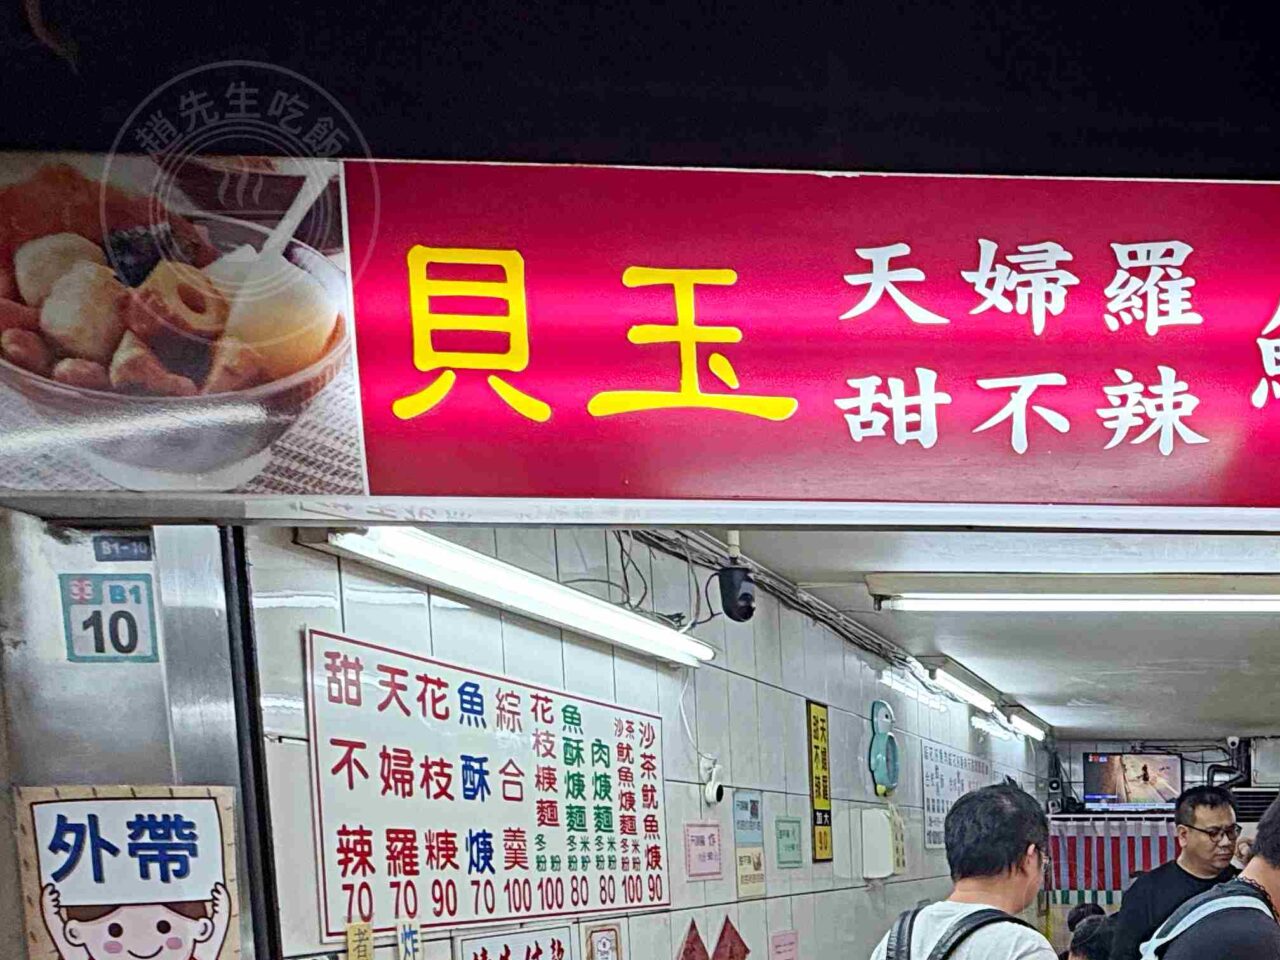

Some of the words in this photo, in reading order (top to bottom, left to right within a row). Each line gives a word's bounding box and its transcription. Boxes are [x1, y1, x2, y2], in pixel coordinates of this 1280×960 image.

[839, 238, 1202, 335] 天婦羅
[392, 244, 799, 422] 貝玉
[834, 365, 1209, 455] 甜不辣
[109, 584, 141, 604] B1
[82, 610, 138, 654] 10
[324, 651, 376, 877] 甜不辣
[377, 664, 420, 877] 天婦羅
[495, 688, 529, 870] 綜合羹
[48, 813, 198, 884] 外帶
[342, 881, 373, 923] 70
[389, 880, 417, 919] 70
[431, 879, 458, 917] 90
[470, 879, 495, 915] 70
[504, 877, 532, 913] 100
[537, 874, 564, 910] 100
[571, 875, 588, 907] 80
[600, 874, 615, 905] 80
[622, 874, 643, 904] 100
[648, 874, 662, 901] 90
